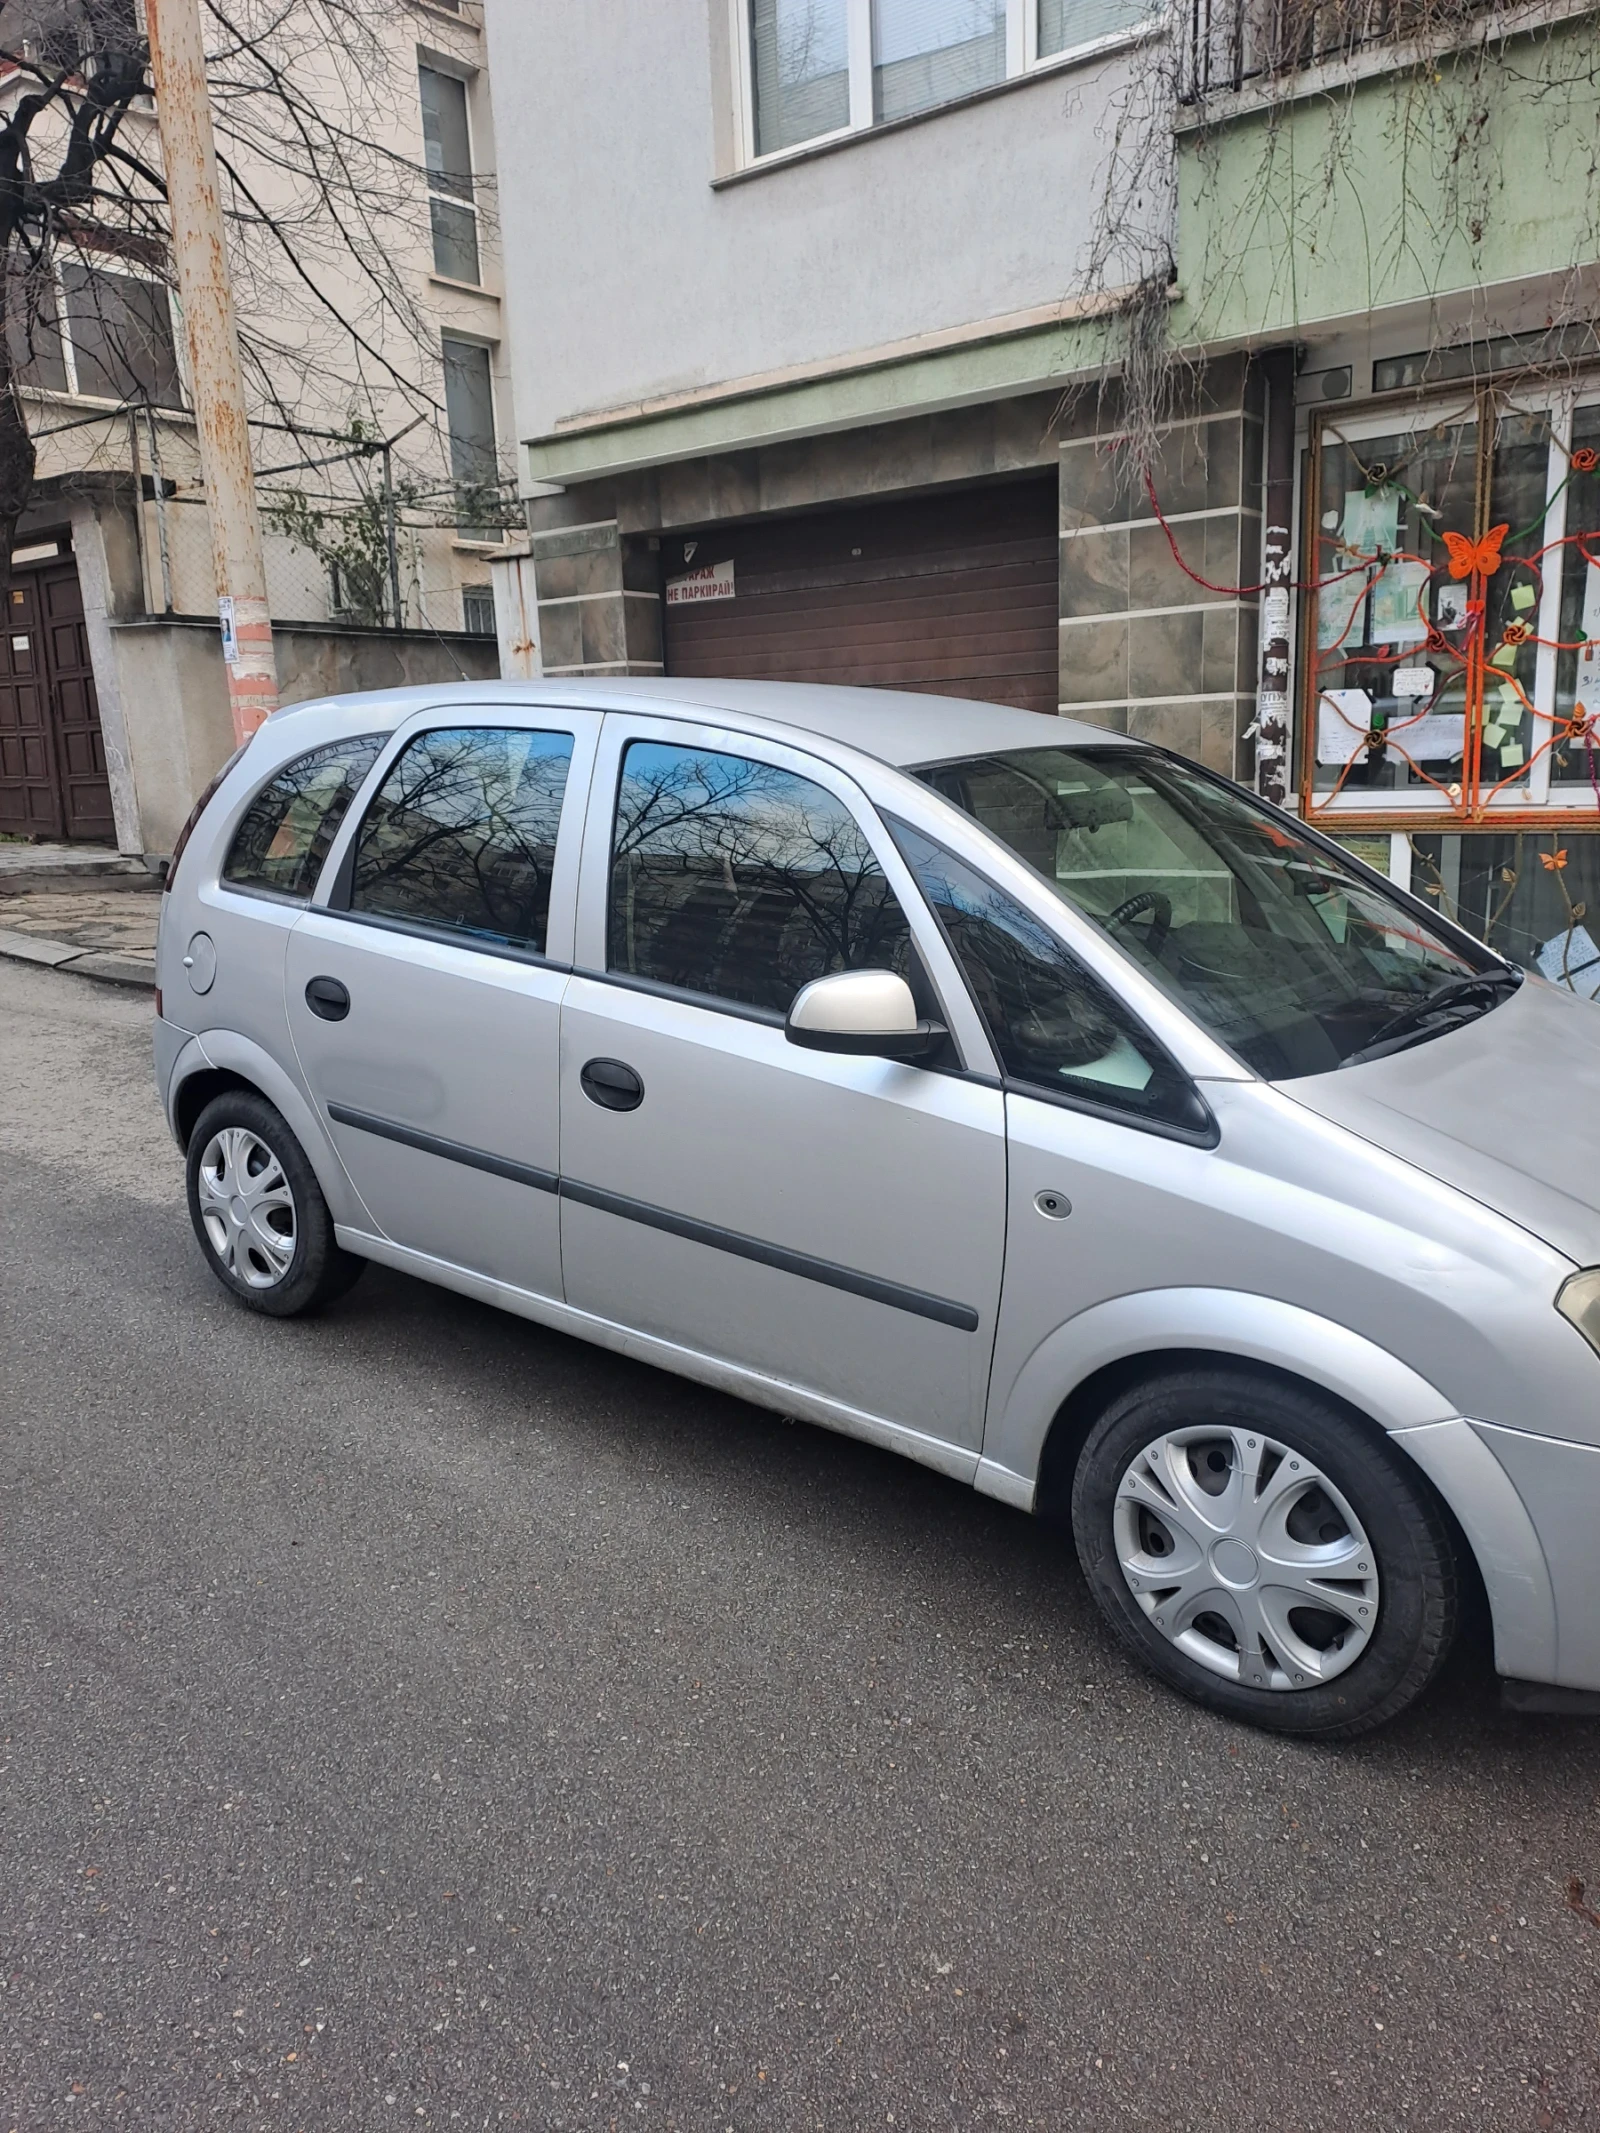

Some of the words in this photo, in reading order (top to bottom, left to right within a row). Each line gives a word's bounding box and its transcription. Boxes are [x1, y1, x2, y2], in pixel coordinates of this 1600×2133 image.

[684, 566, 714, 581] АРАЖ
[668, 588, 678, 601] НЕ
[682, 580, 734, 599] ПАРКИРАЙ!
